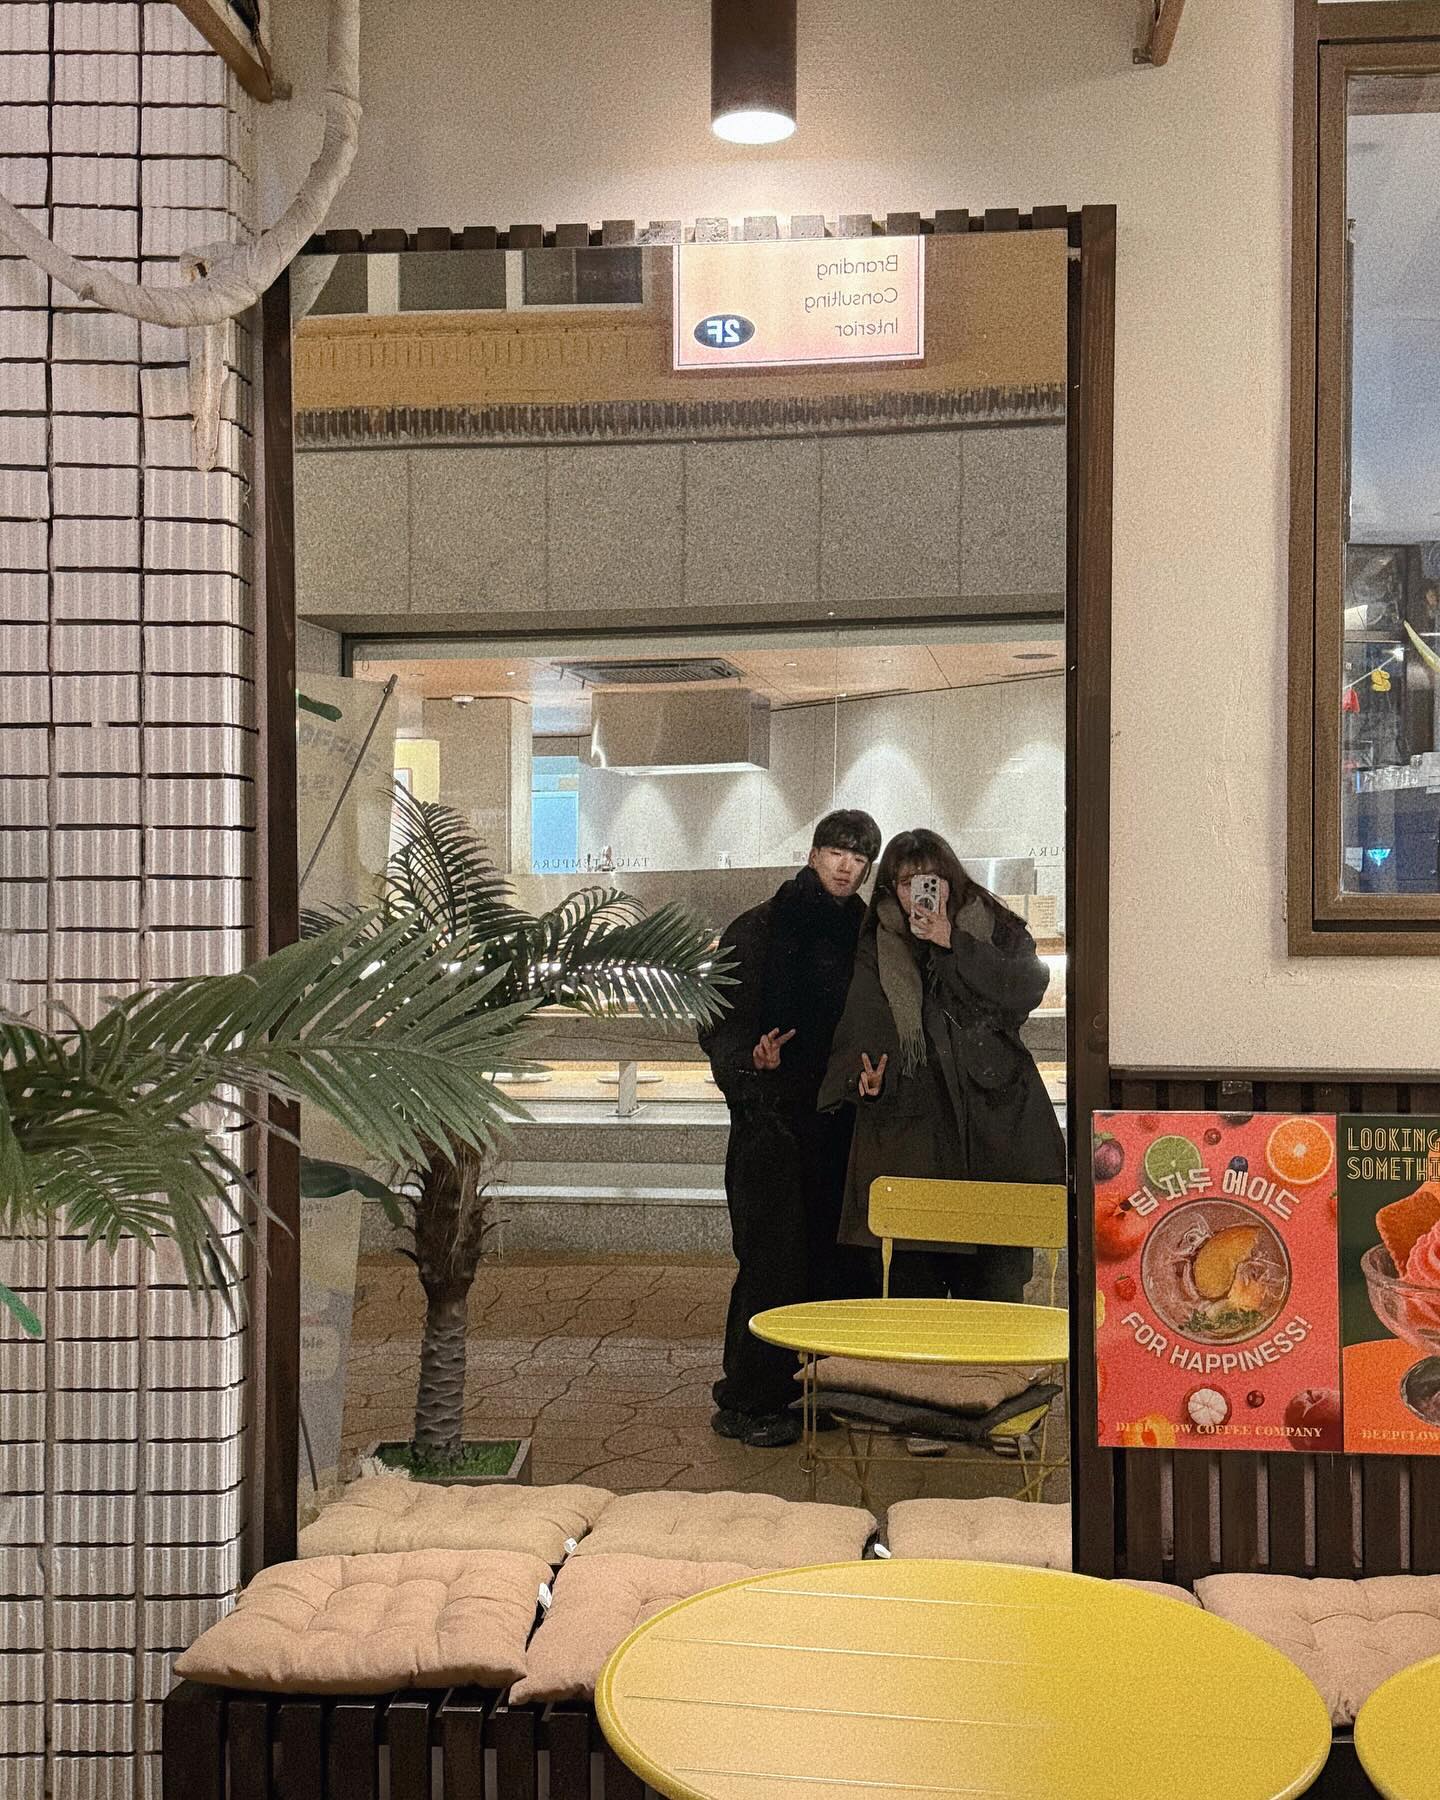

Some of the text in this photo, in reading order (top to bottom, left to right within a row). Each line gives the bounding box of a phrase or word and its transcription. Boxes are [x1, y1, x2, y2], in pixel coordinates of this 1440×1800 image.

[1347, 1127, 1440, 1152] LOOKING
[1158, 1167, 1214, 1201] 자두
[1222, 1168, 1301, 1221] 에이드
[1120, 1311, 1313, 1374] FOR HAPPINESS!
[1196, 1423, 1251, 1435] COFFEE
[1255, 1425, 1322, 1438] COMPANY
